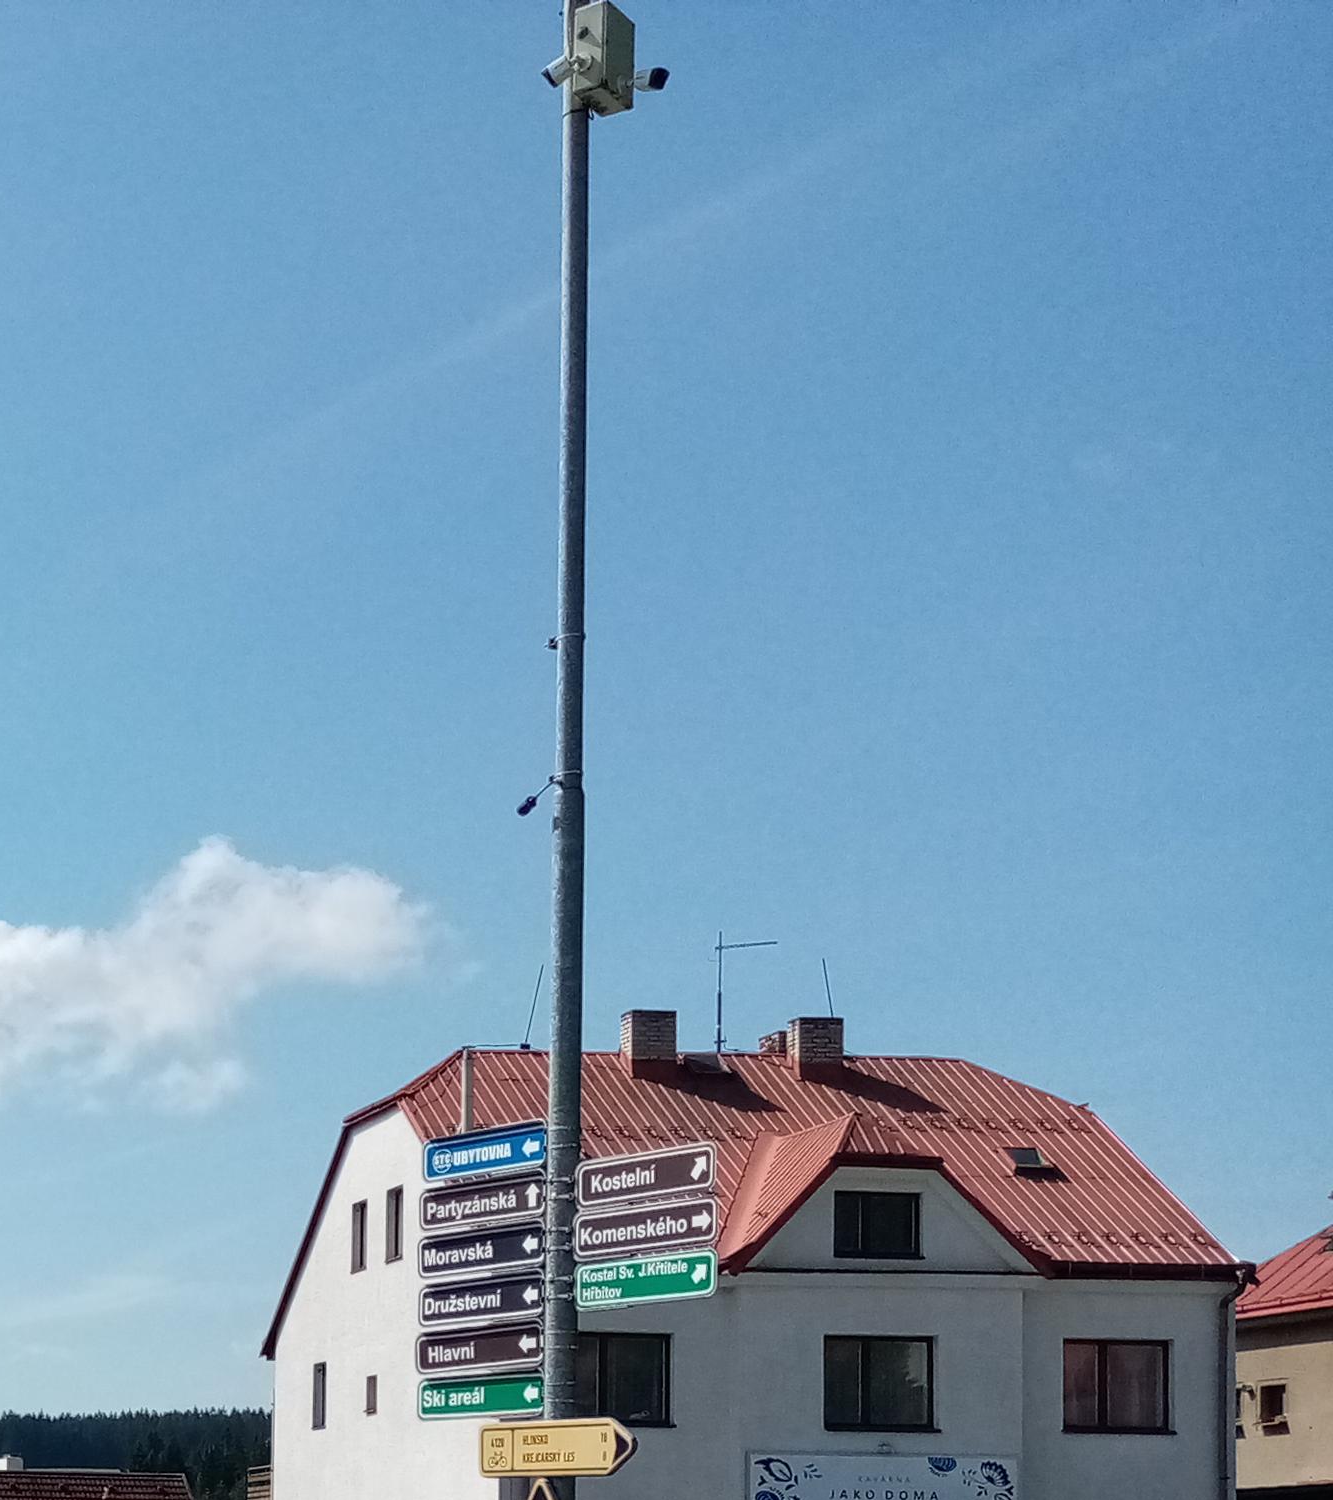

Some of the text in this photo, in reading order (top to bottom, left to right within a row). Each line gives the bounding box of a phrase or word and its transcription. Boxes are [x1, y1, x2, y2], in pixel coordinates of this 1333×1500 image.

[453, 1143, 512, 1166] UBYTOVNA
[590, 1164, 656, 1194] Kostelní
[427, 1190, 517, 1220] Partyzánská
[580, 1216, 688, 1246] Komenského
[424, 1240, 493, 1267] Moravská
[582, 1268, 617, 1283] Kostel
[619, 1266, 635, 1280] Sv.
[424, 1289, 501, 1315] Družstevní
[582, 1287, 622, 1301] Hřbitov
[428, 1341, 475, 1364] Hlavní
[423, 1386, 485, 1408] Ski areál
[564, 1451, 575, 1463] LES
[830, 1489, 939, 1500] JAKO DOMA
